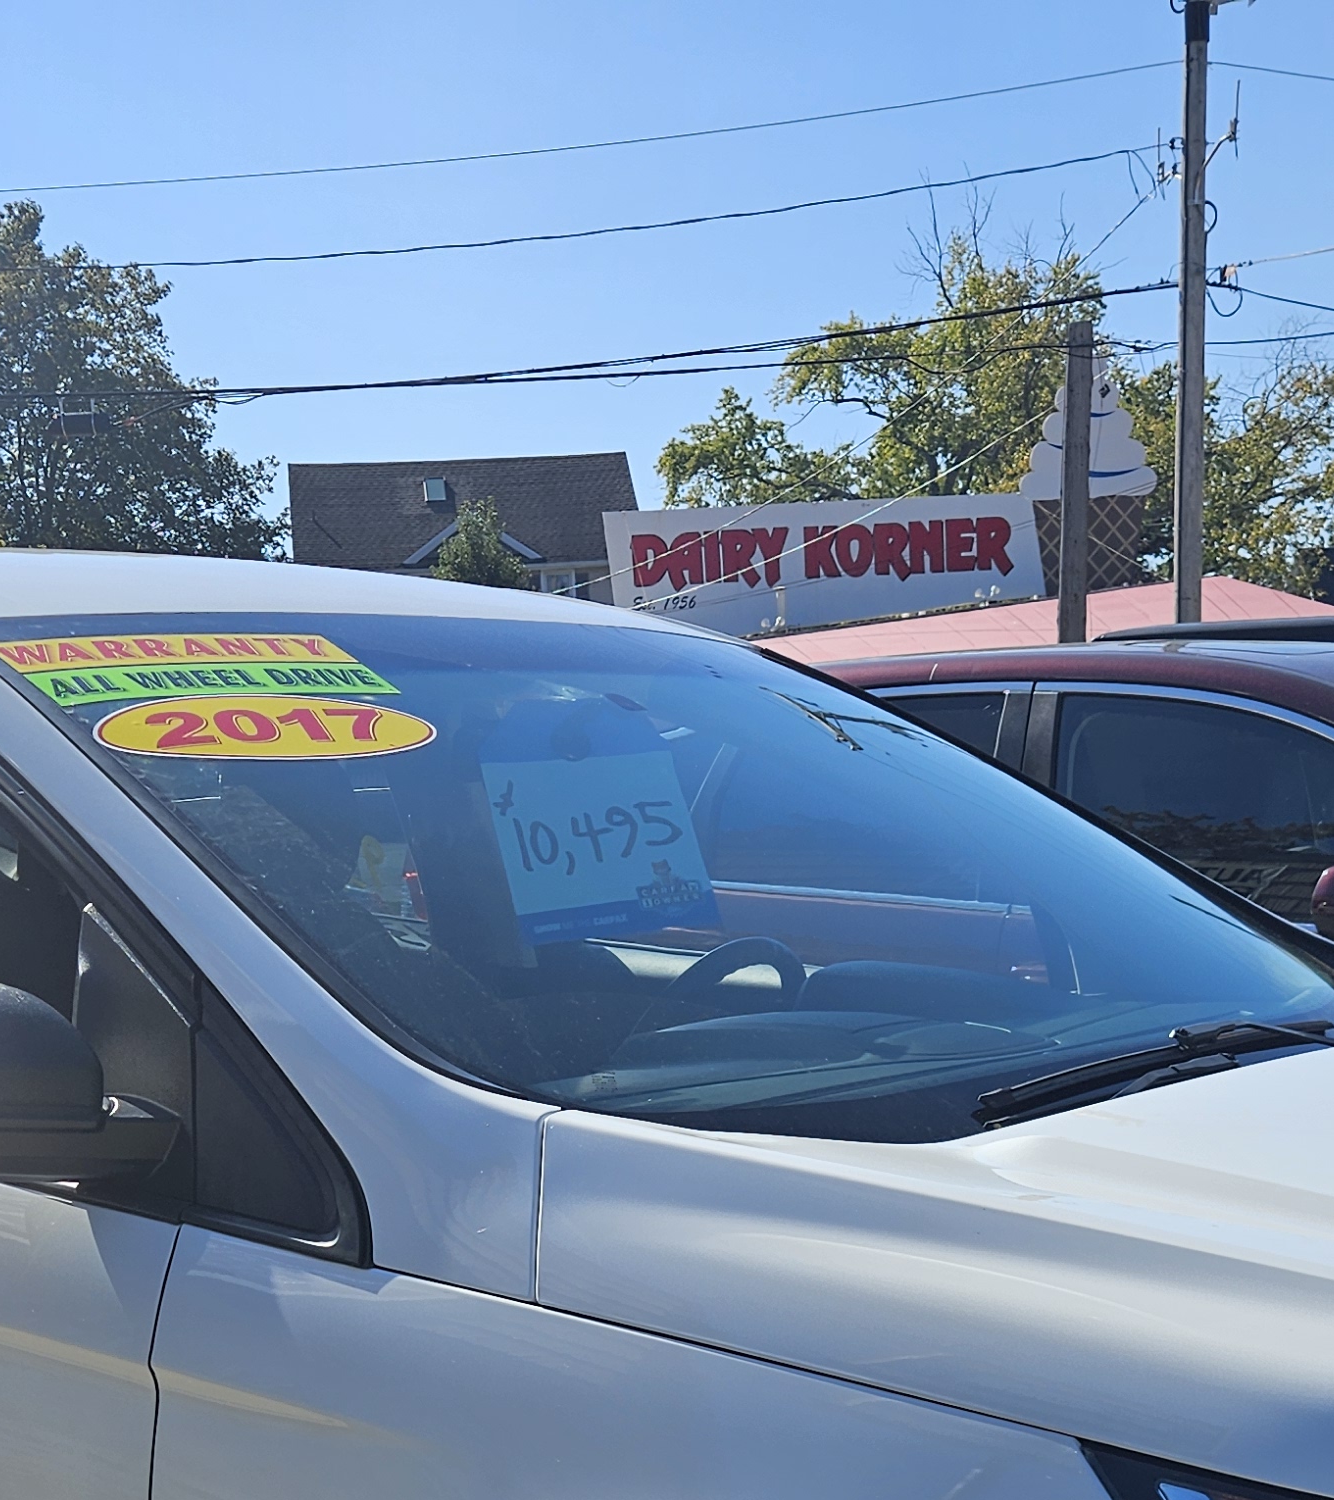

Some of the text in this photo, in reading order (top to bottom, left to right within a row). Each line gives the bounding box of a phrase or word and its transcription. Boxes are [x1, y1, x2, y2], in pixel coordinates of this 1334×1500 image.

[630, 517, 1014, 591] DAIRY KORNER
[664, 595, 696, 610] 1956
[50, 666, 383, 698] ALL WHEEL DRIVE
[144, 708, 384, 750] 2017
